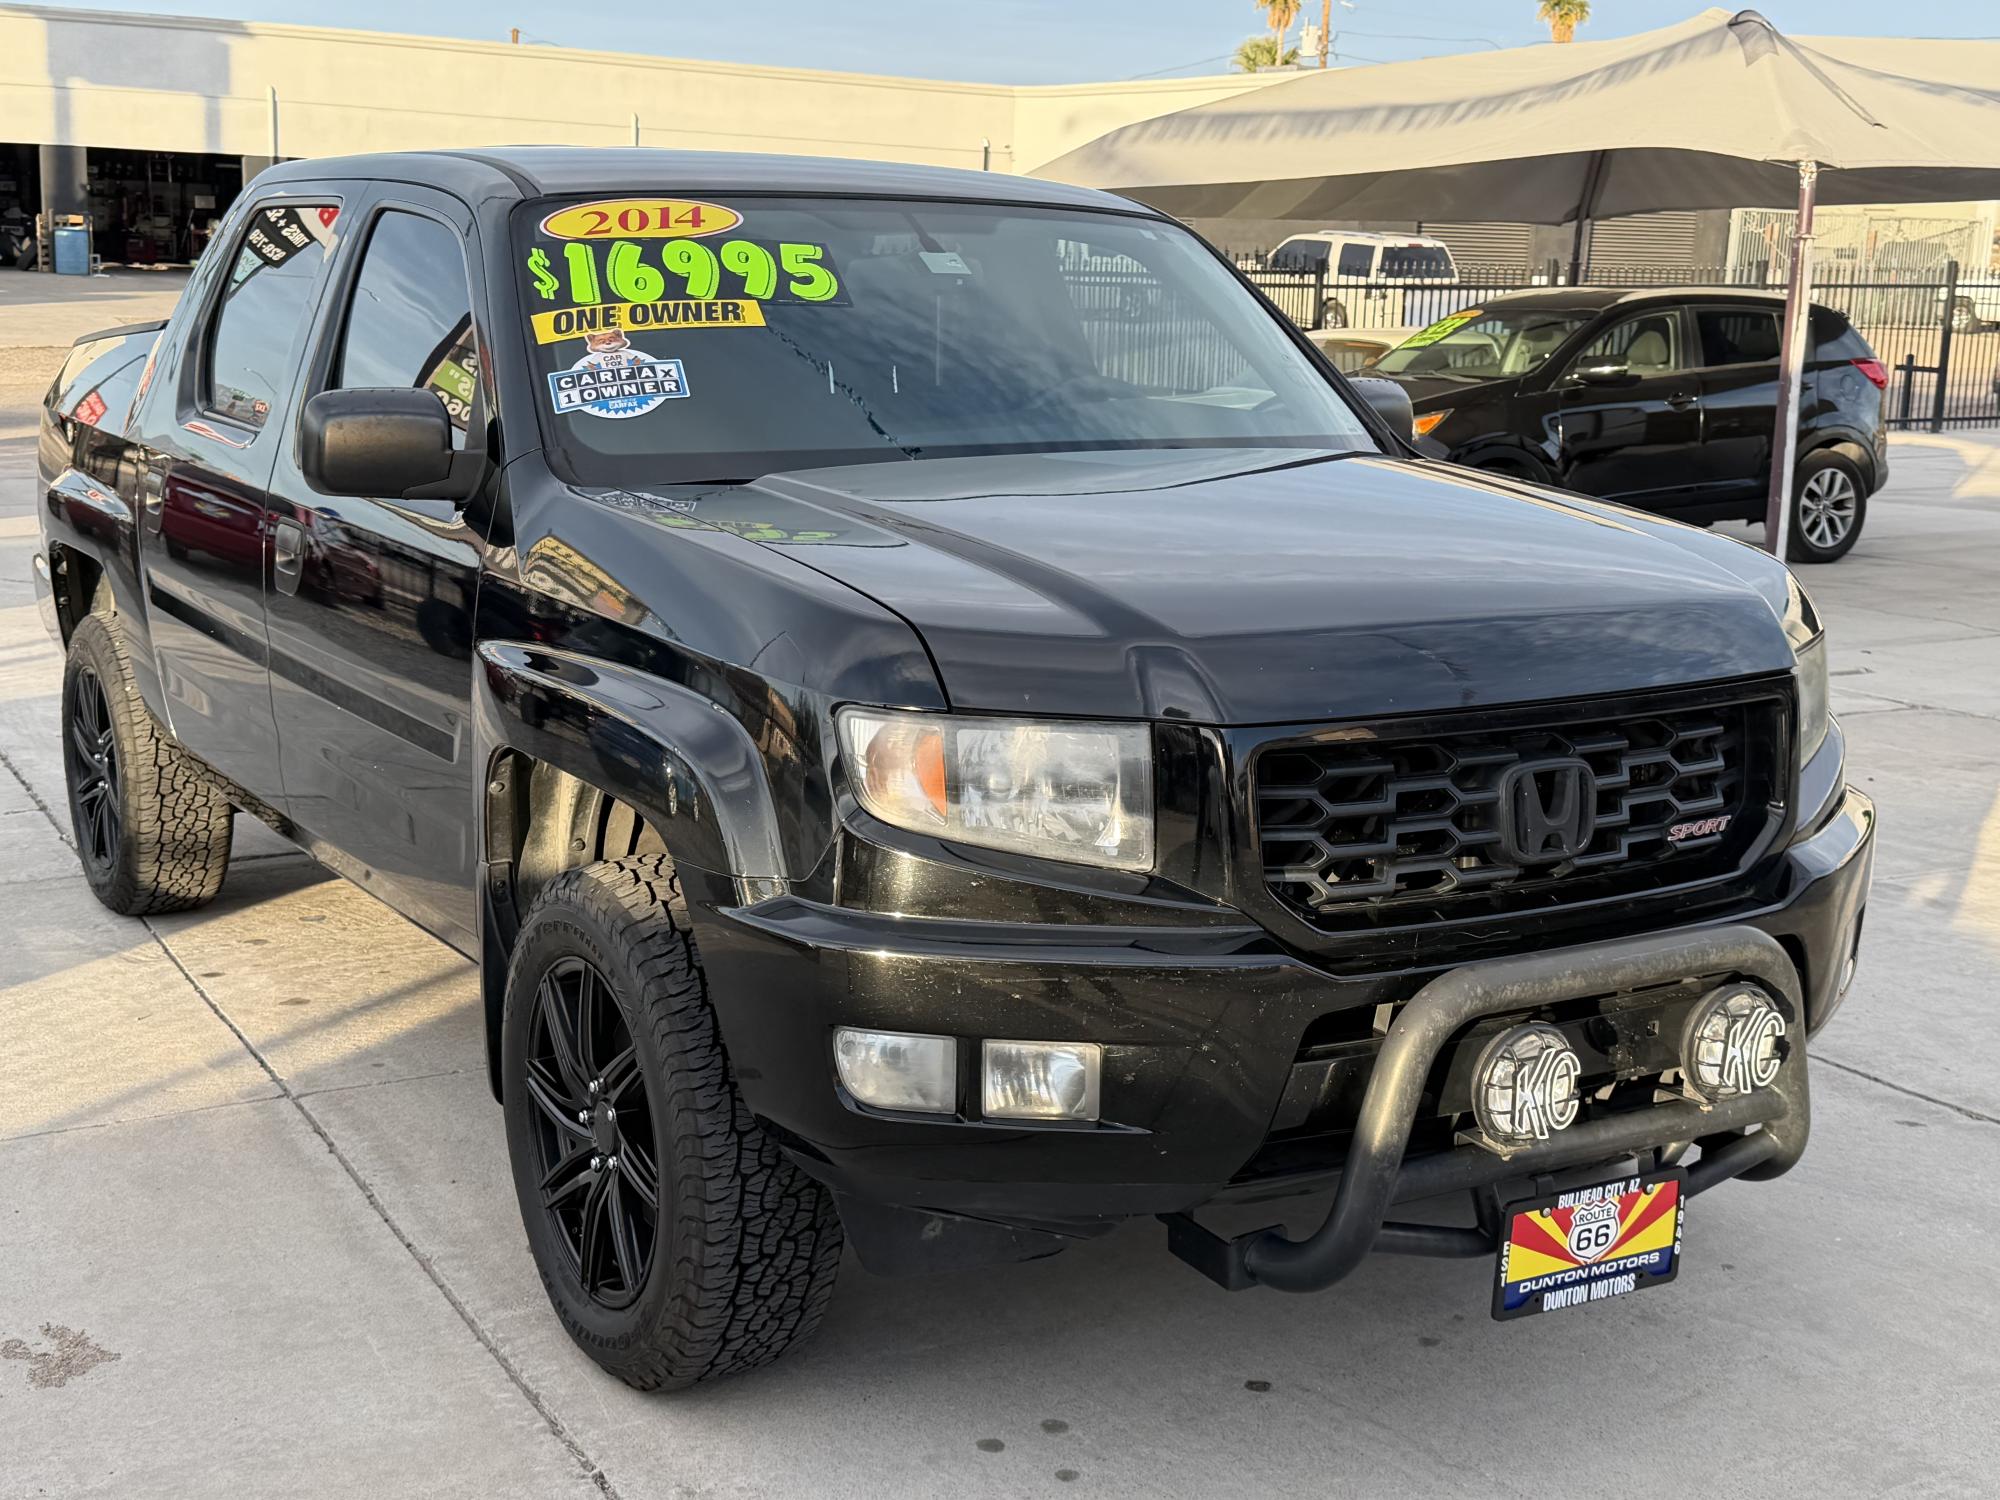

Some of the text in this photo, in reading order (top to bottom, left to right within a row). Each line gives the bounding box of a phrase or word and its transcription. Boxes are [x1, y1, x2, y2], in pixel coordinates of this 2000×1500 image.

[580, 205, 706, 236] 2014
[527, 239, 838, 305] $16995
[552, 300, 745, 335] ONE OWNER
[603, 354, 622, 362] CAR
[559, 366, 674, 389] CARFAX
[563, 381, 678, 405] 1 OWNER
[1667, 815, 1732, 841] SPORT
[1721, 1006, 1787, 1094] KC
[1511, 1047, 1581, 1140] KC
[1557, 1178, 1641, 1210] BULLHEAD CITY, AZ
[1578, 1207, 1613, 1223] ROUTE
[1673, 1195, 1686, 1256] 1946
[1576, 1224, 1611, 1251] 66
[1500, 1240, 1511, 1288] EST
[1519, 1252, 1660, 1294] DUNTON MOTORS
[1543, 1273, 1636, 1312] DUNTON MOTORS
